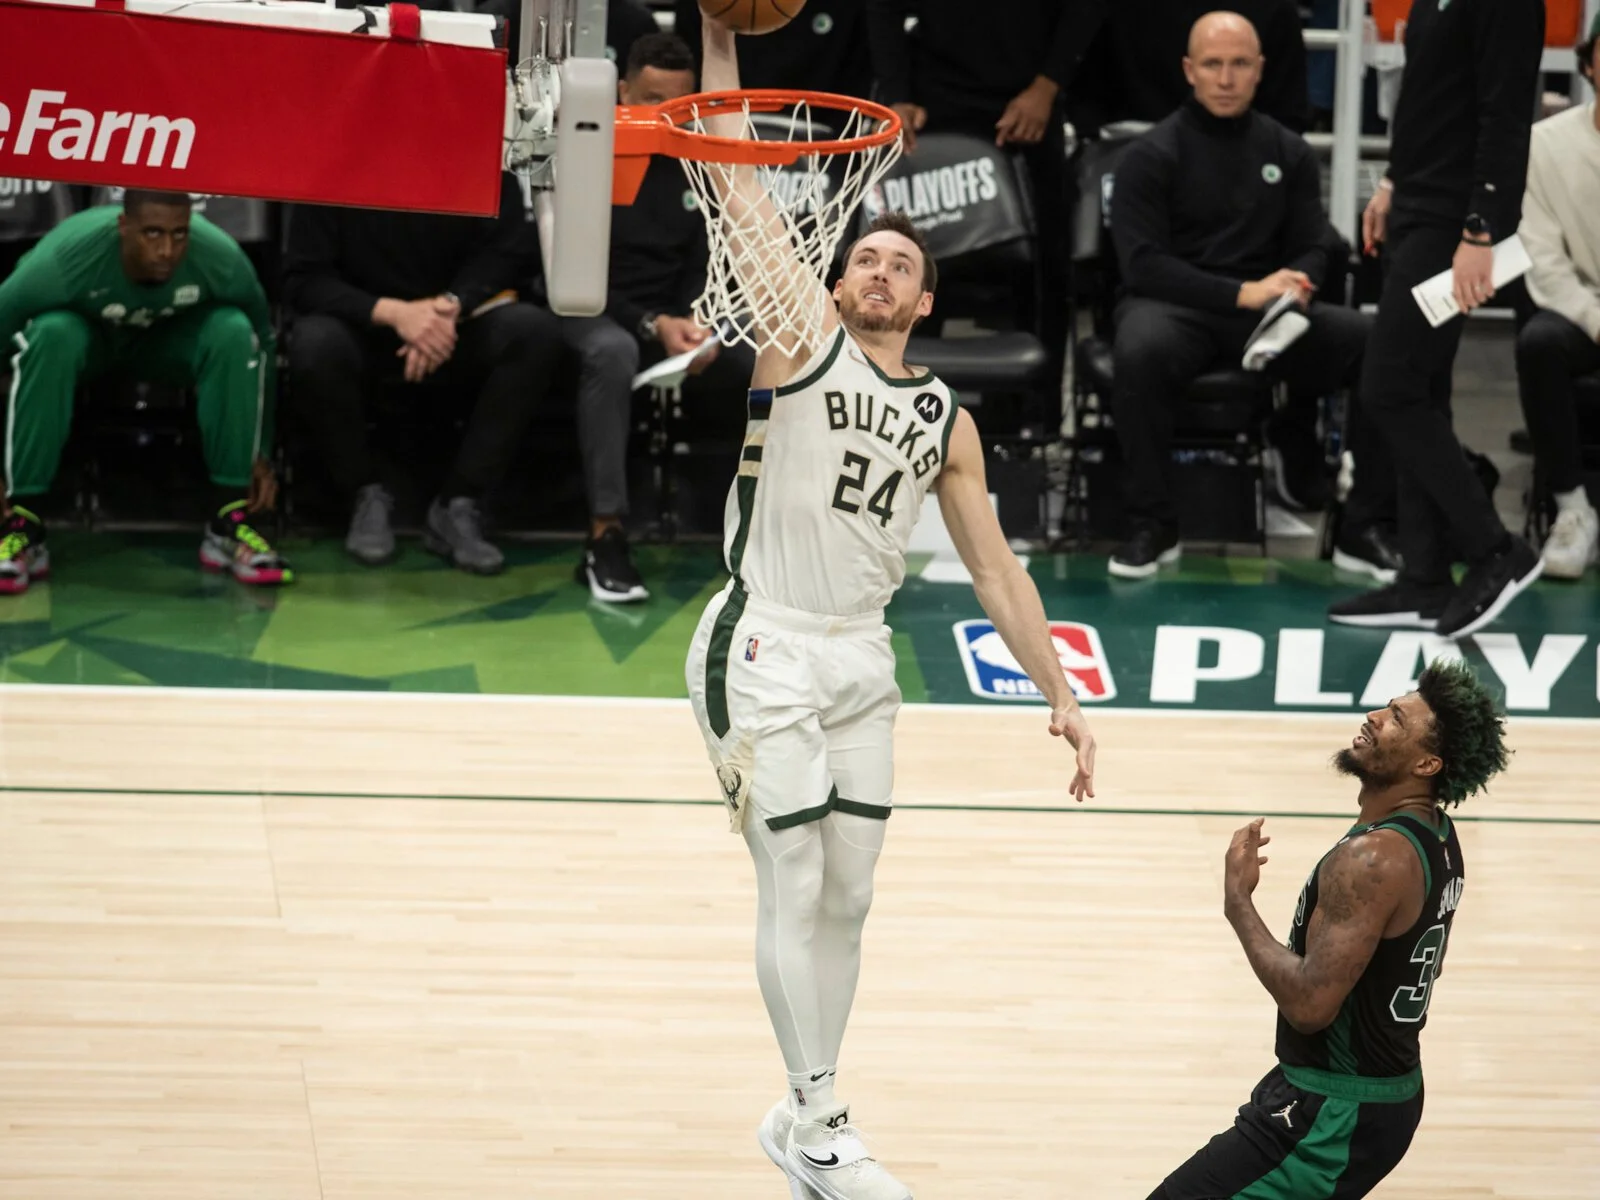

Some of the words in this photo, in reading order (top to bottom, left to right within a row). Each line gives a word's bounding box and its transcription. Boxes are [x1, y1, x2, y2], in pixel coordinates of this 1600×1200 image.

[13, 88, 196, 170] Farm
[884, 156, 998, 218] PLAYOFFS
[824, 391, 940, 480] BUCKS
[832, 450, 904, 528] 24
[992, 678, 1045, 694] NB
[1149, 625, 1600, 710] PLAY
[1437, 876, 1465, 920] SMAR
[1389, 924, 1446, 1023] 3
